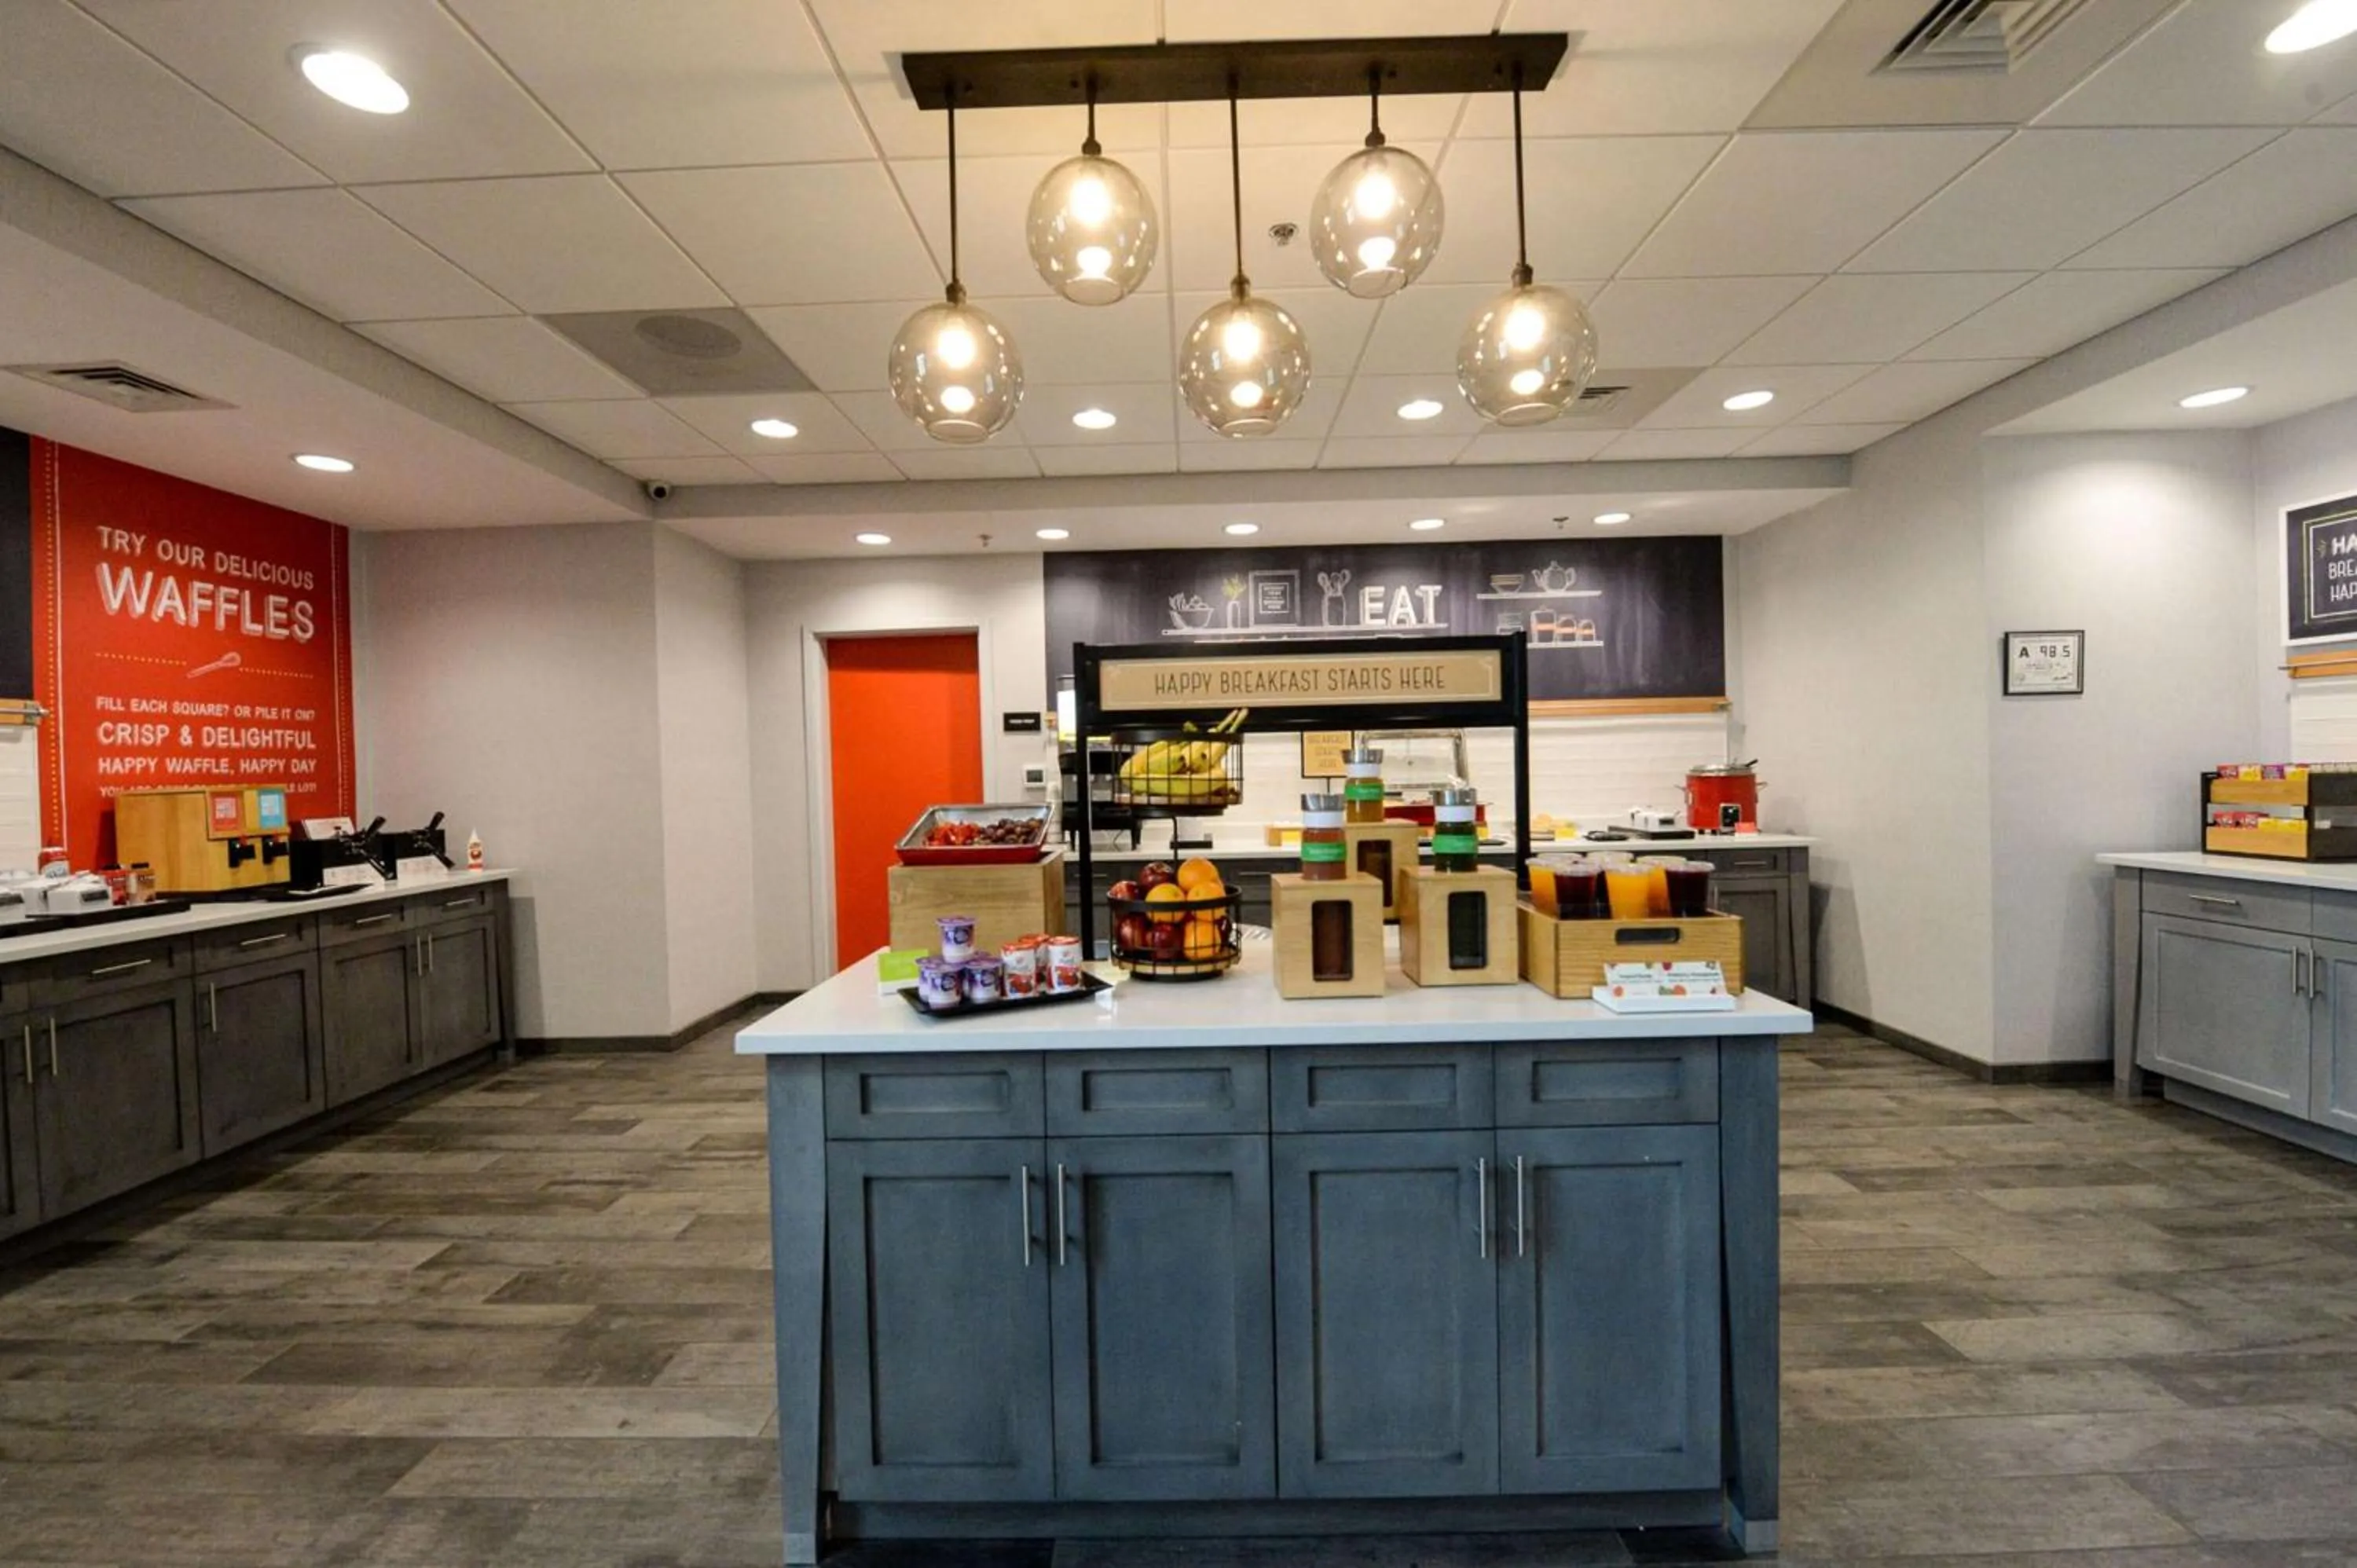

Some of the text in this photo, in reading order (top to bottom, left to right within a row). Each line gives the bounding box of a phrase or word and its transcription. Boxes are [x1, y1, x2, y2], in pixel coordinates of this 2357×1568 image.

[97, 525, 314, 591] TRY OUR DELICIOUS
[2328, 559, 2357, 580] BRE
[95, 562, 314, 644] WAFFLES
[1359, 585, 1442, 628] EAT
[2018, 647, 2030, 658] A
[1154, 665, 1446, 695] HAPPY BREAKFAST STARTS HERE
[96, 696, 125, 711] FILL
[130, 698, 167, 713] EACH
[172, 702, 229, 717] SQUARE?
[235, 705, 251, 718] OR
[281, 709, 291, 720] IT
[98, 721, 317, 750] CRISP & DELIGHTFUL
[98, 757, 317, 776] HAPPY WAFFLE, HAPPY DAY
